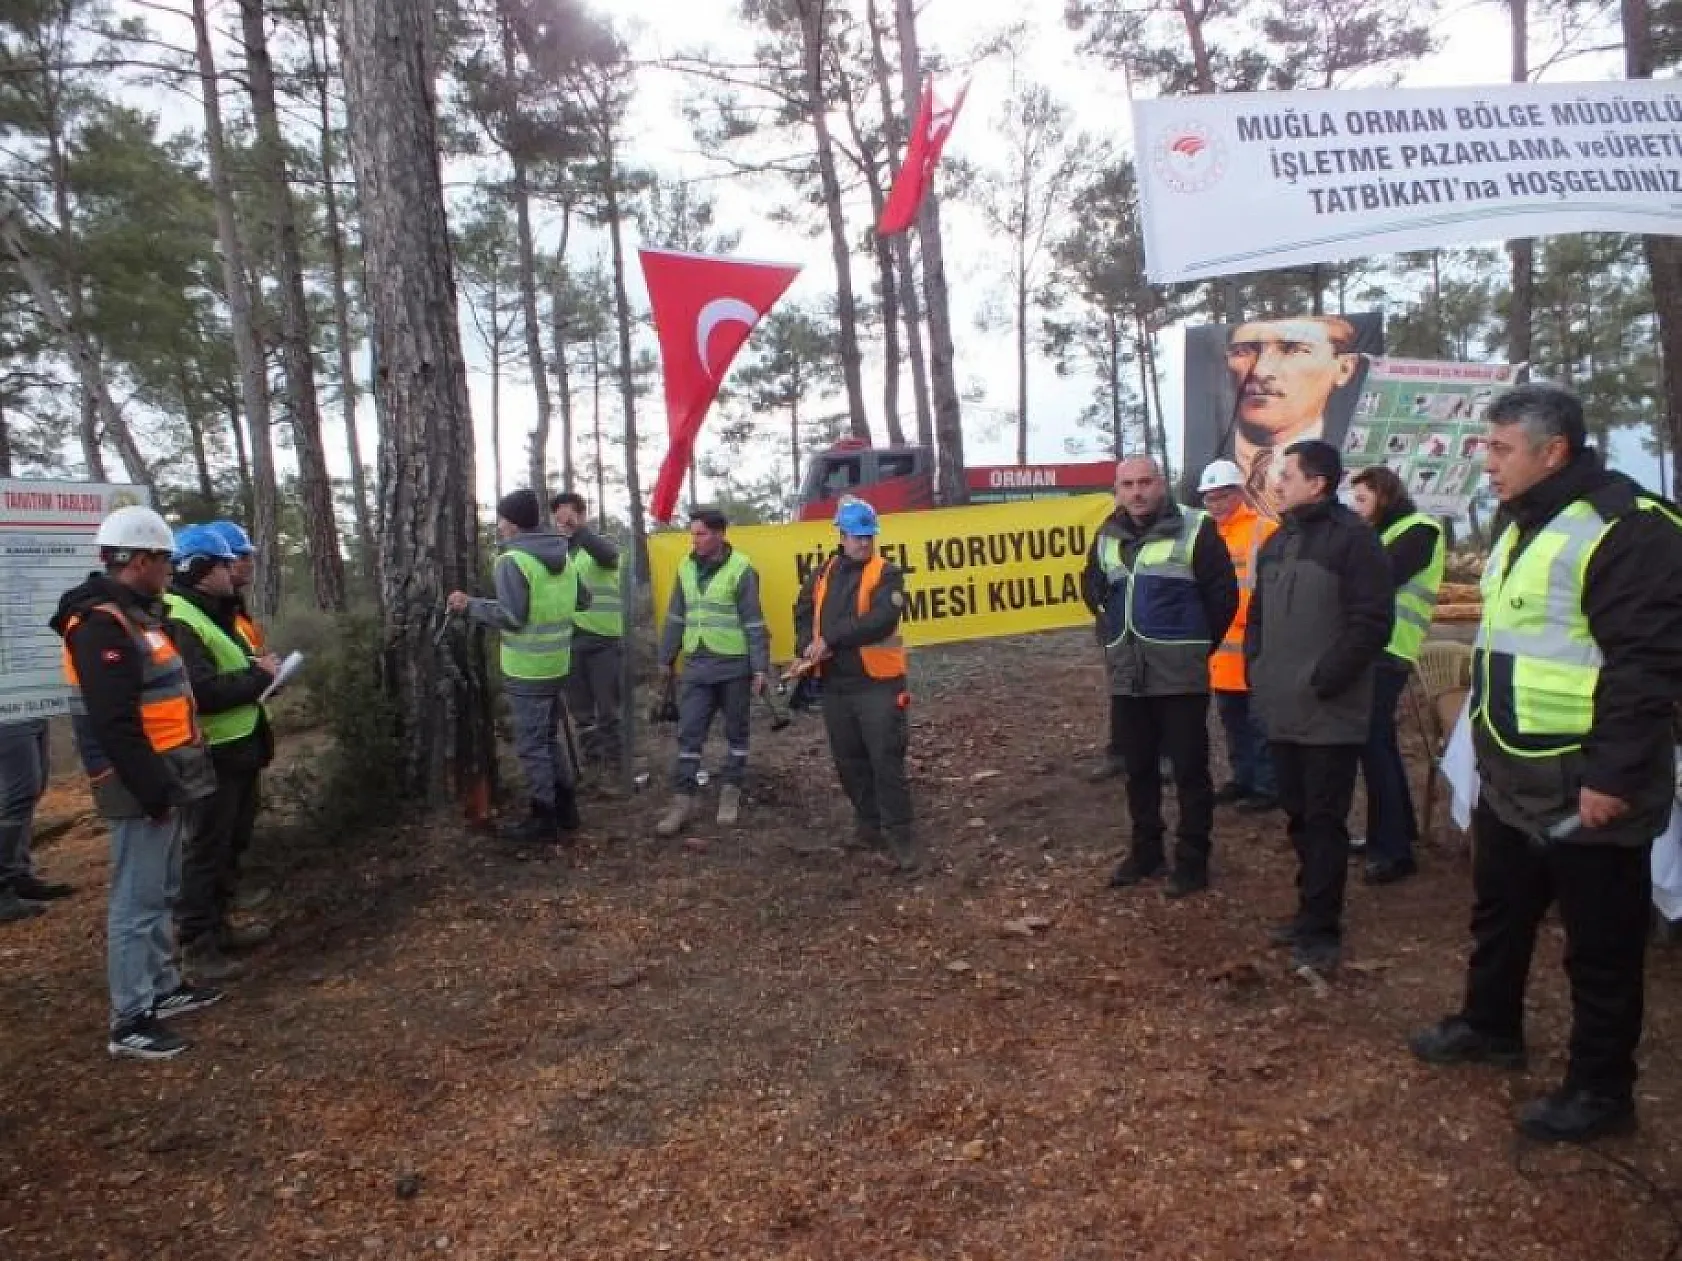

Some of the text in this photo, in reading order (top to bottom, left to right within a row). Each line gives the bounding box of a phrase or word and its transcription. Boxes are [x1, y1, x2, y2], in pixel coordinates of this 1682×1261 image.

[1236, 108, 1338, 142] MUĞLA
[1346, 106, 1449, 134] ORMAN
[1455, 100, 1544, 130] BÖLGE
[1270, 147, 1392, 183] İŞLETME
[1401, 141, 1570, 168] PAZARLAMA
[1507, 164, 1682, 199] HOŞGELDİNİZ
[990, 468, 1056, 488] ORMAN
[925, 526, 1085, 571] KORUYUCU
[988, 570, 1085, 612] KULLA
